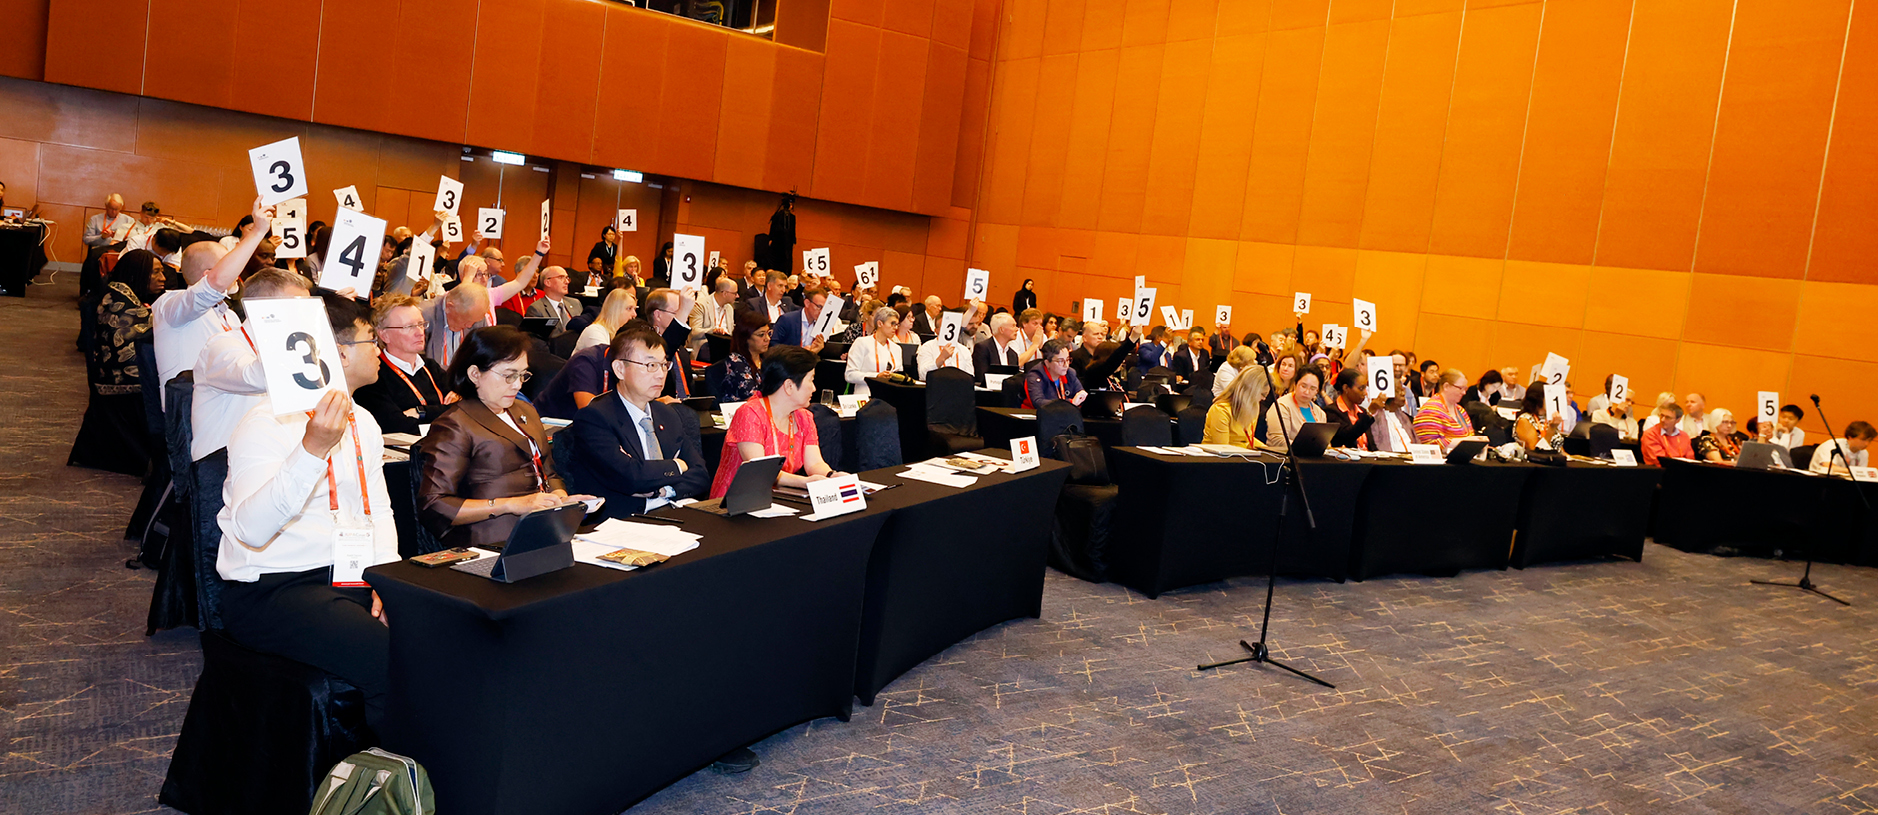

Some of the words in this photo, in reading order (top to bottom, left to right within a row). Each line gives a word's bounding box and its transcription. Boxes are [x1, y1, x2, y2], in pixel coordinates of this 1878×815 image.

[269, 160, 295, 193] 3
[343, 194, 355, 208] 4
[443, 190, 456, 209] 3
[448, 222, 458, 236] 5
[485, 217, 497, 233] 2
[543, 212, 548, 233] 2
[622, 215, 632, 227] 4
[283, 227, 300, 249] 5
[338, 234, 367, 278] 4
[711, 257, 717, 269] 3
[817, 255, 827, 271] 5
[418, 254, 426, 276] 1
[682, 252, 697, 282] 3
[860, 271, 870, 285] 6
[972, 277, 984, 294] 5
[1120, 304, 1129, 317] 3
[1138, 297, 1150, 318] 5
[1298, 298, 1307, 310] 3
[1090, 306, 1096, 319] 1
[1168, 313, 1177, 327] 1
[1219, 310, 1228, 322] 3
[1360, 310, 1371, 326] 3
[820, 310, 834, 333] 1
[1185, 316, 1190, 328] 1
[944, 323, 956, 342] 3
[1325, 329, 1334, 342] 4
[286, 331, 331, 390] 3
[1375, 369, 1389, 391] 6
[1551, 372, 1562, 385] 2
[1614, 384, 1624, 400] 2
[1553, 396, 1560, 412] 1
[1765, 400, 1775, 416] 5
[816, 493, 839, 505] Thailand
